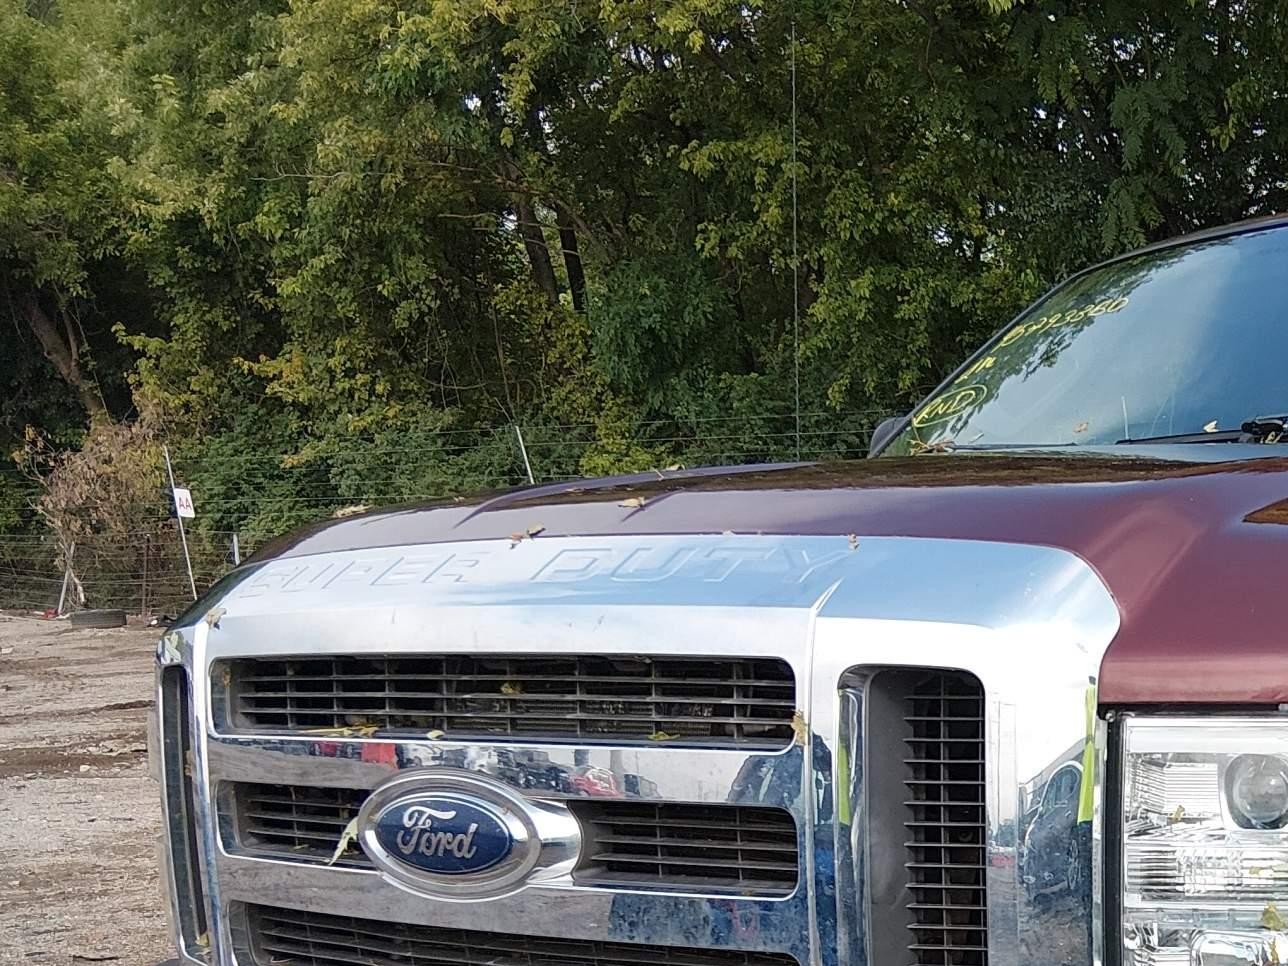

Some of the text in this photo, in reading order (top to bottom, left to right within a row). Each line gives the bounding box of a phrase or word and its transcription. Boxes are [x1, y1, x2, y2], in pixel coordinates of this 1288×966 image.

[240, 547, 852, 598] SUPER DUTY
[397, 806, 479, 859] Ford
